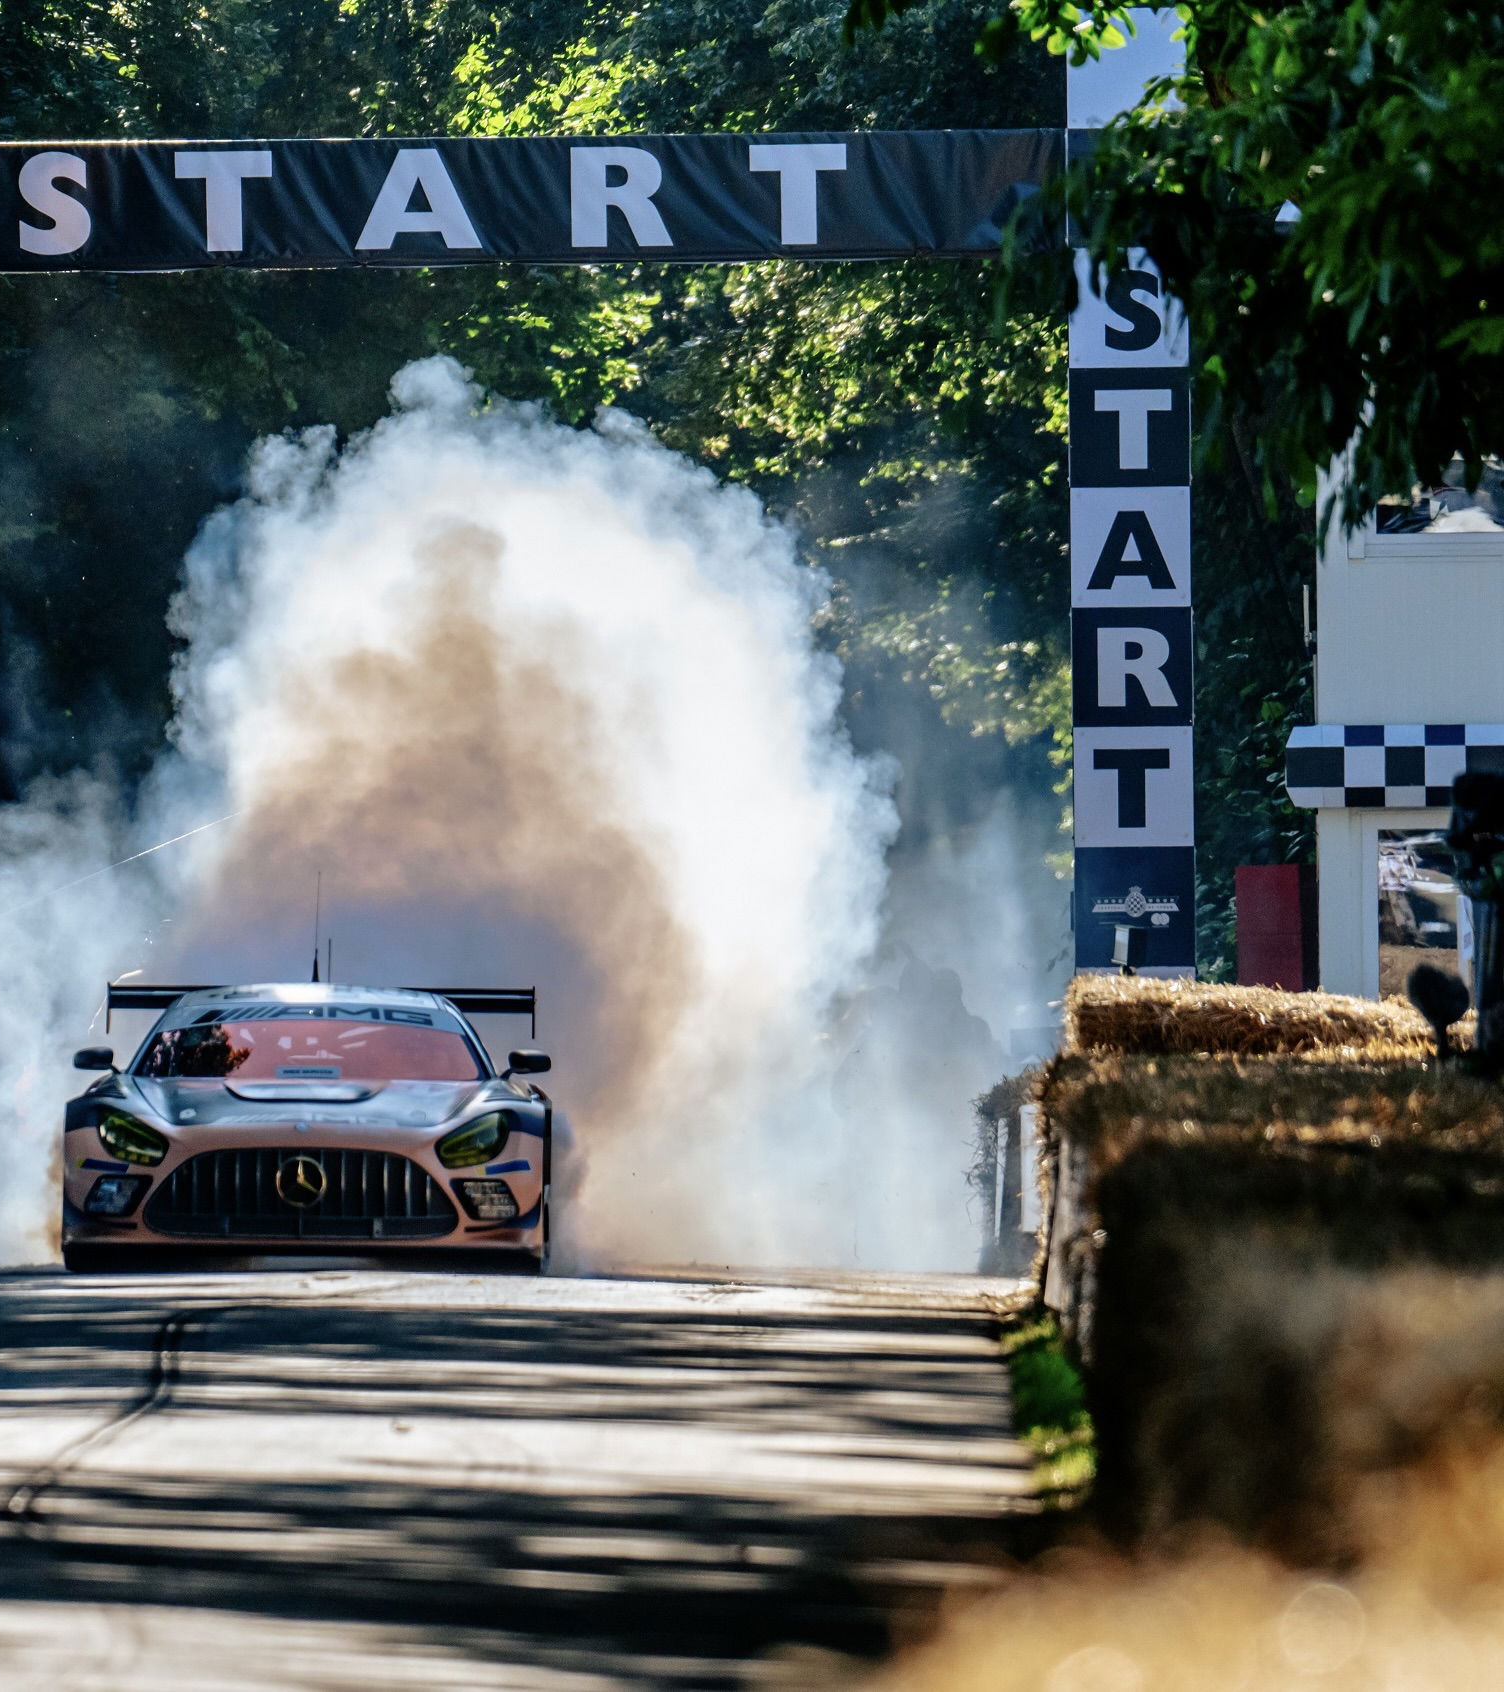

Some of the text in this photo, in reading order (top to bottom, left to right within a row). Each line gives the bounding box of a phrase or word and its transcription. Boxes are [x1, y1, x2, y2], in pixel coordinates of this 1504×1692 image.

[18, 144, 849, 255] START
[1087, 269, 1178, 828] START
[266, 1006, 434, 1026] AMG
